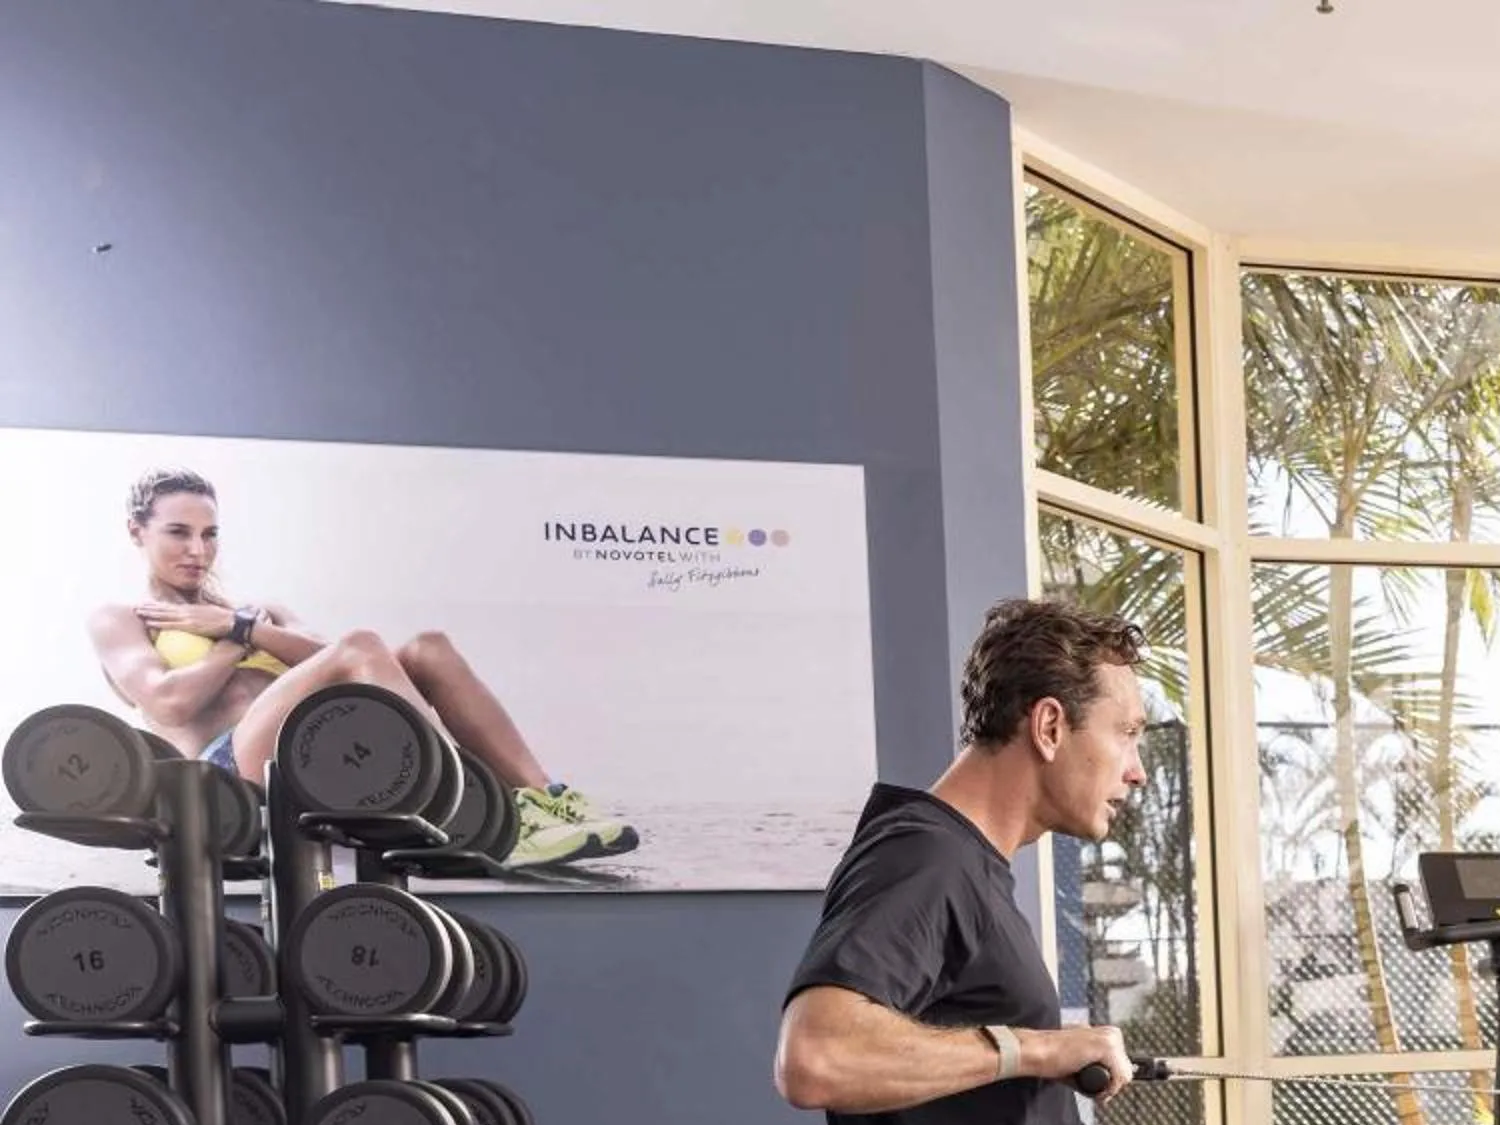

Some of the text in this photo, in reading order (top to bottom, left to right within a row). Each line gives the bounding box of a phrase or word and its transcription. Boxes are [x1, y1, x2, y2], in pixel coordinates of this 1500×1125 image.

[544, 521, 719, 546] INBALANCE
[595, 550, 676, 562] NOVOTEL
[679, 552, 721, 563] WITH
[58, 752, 91, 782] 12
[341, 740, 373, 771] 14
[72, 949, 105, 974] 16
[350, 944, 381, 968] 18
